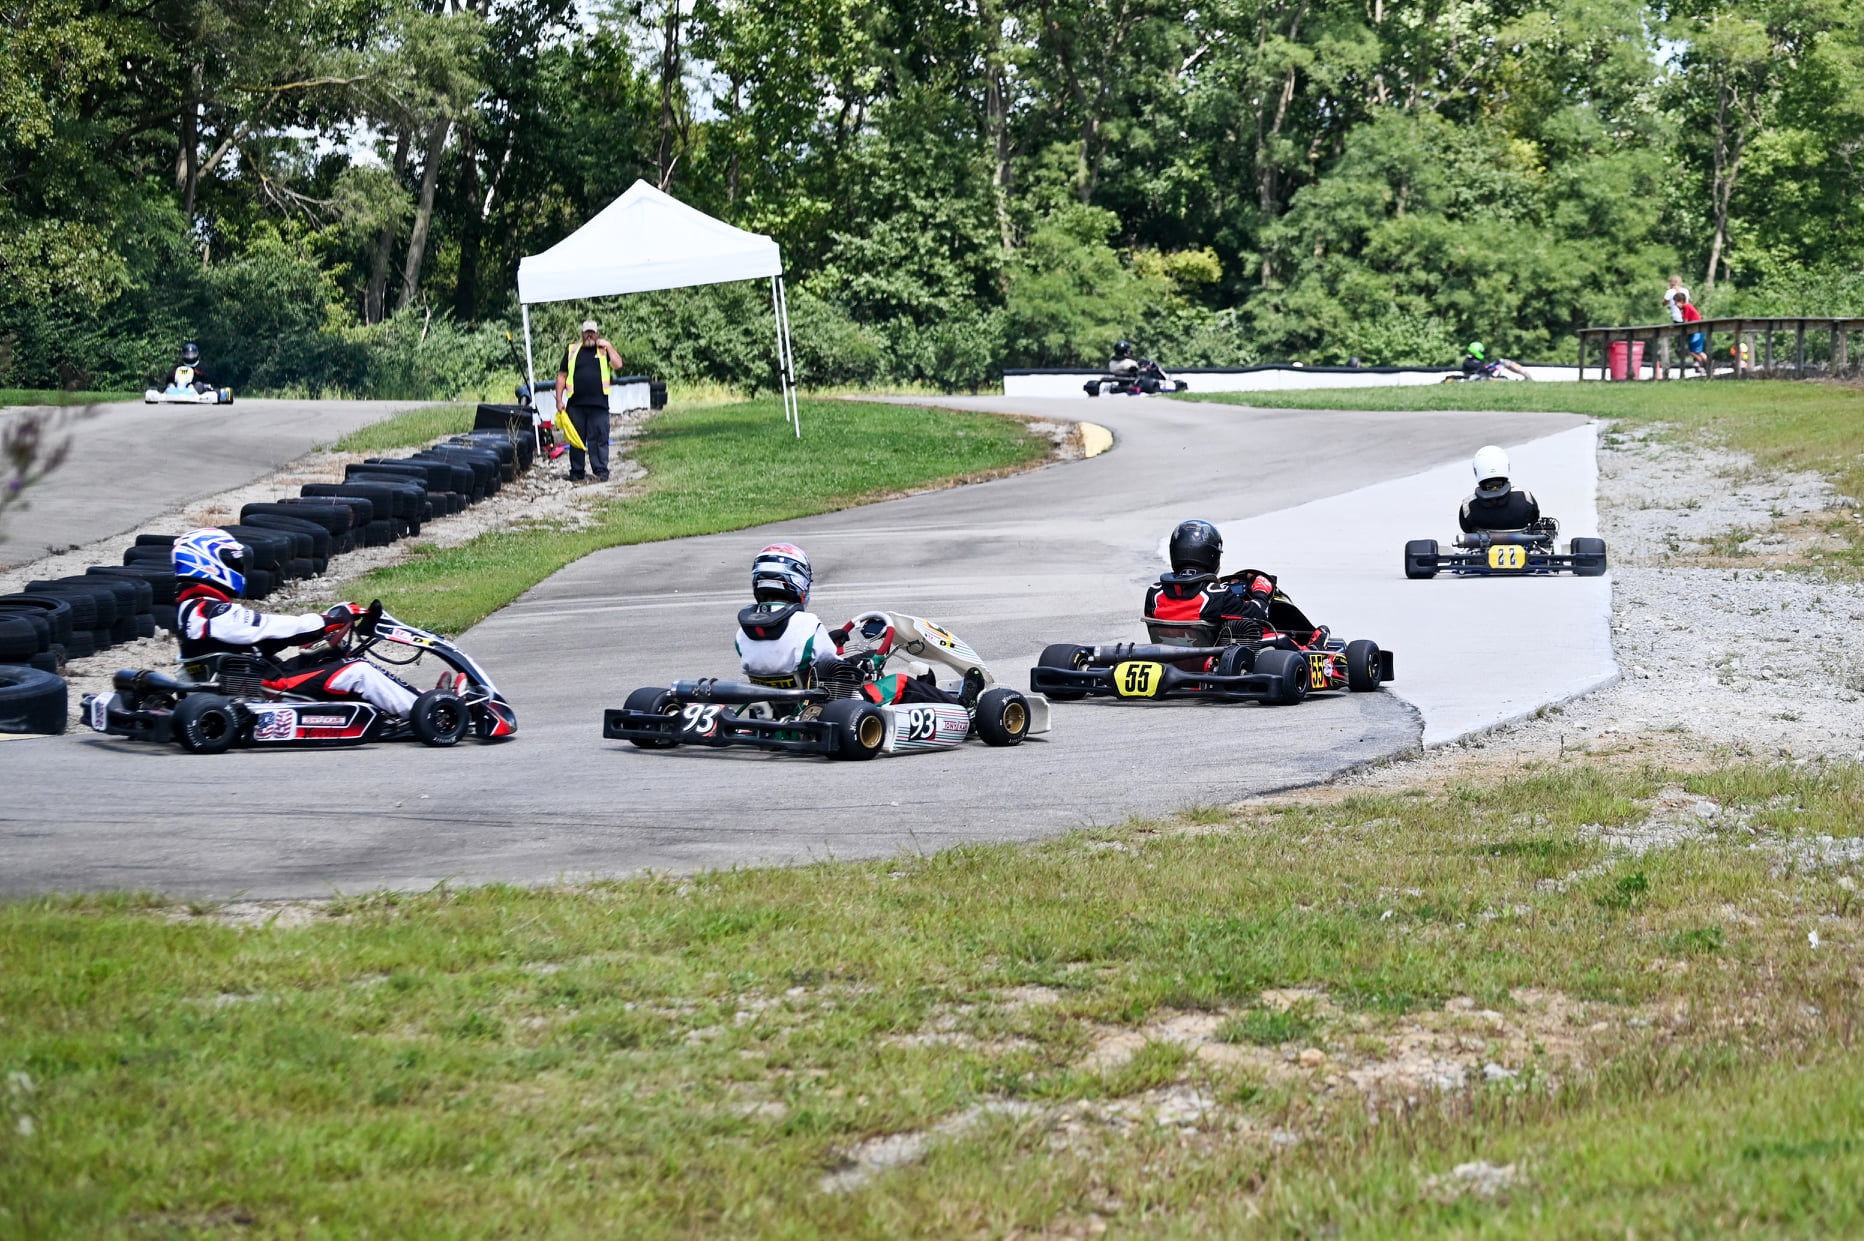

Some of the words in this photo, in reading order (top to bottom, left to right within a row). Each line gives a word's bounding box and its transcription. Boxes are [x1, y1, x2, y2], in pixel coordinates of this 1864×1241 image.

[1498, 548, 1516, 567] 22
[1125, 664, 1152, 693] 55
[1311, 655, 1324, 687] 55
[683, 704, 720, 733] 93
[910, 709, 936, 739] 93
